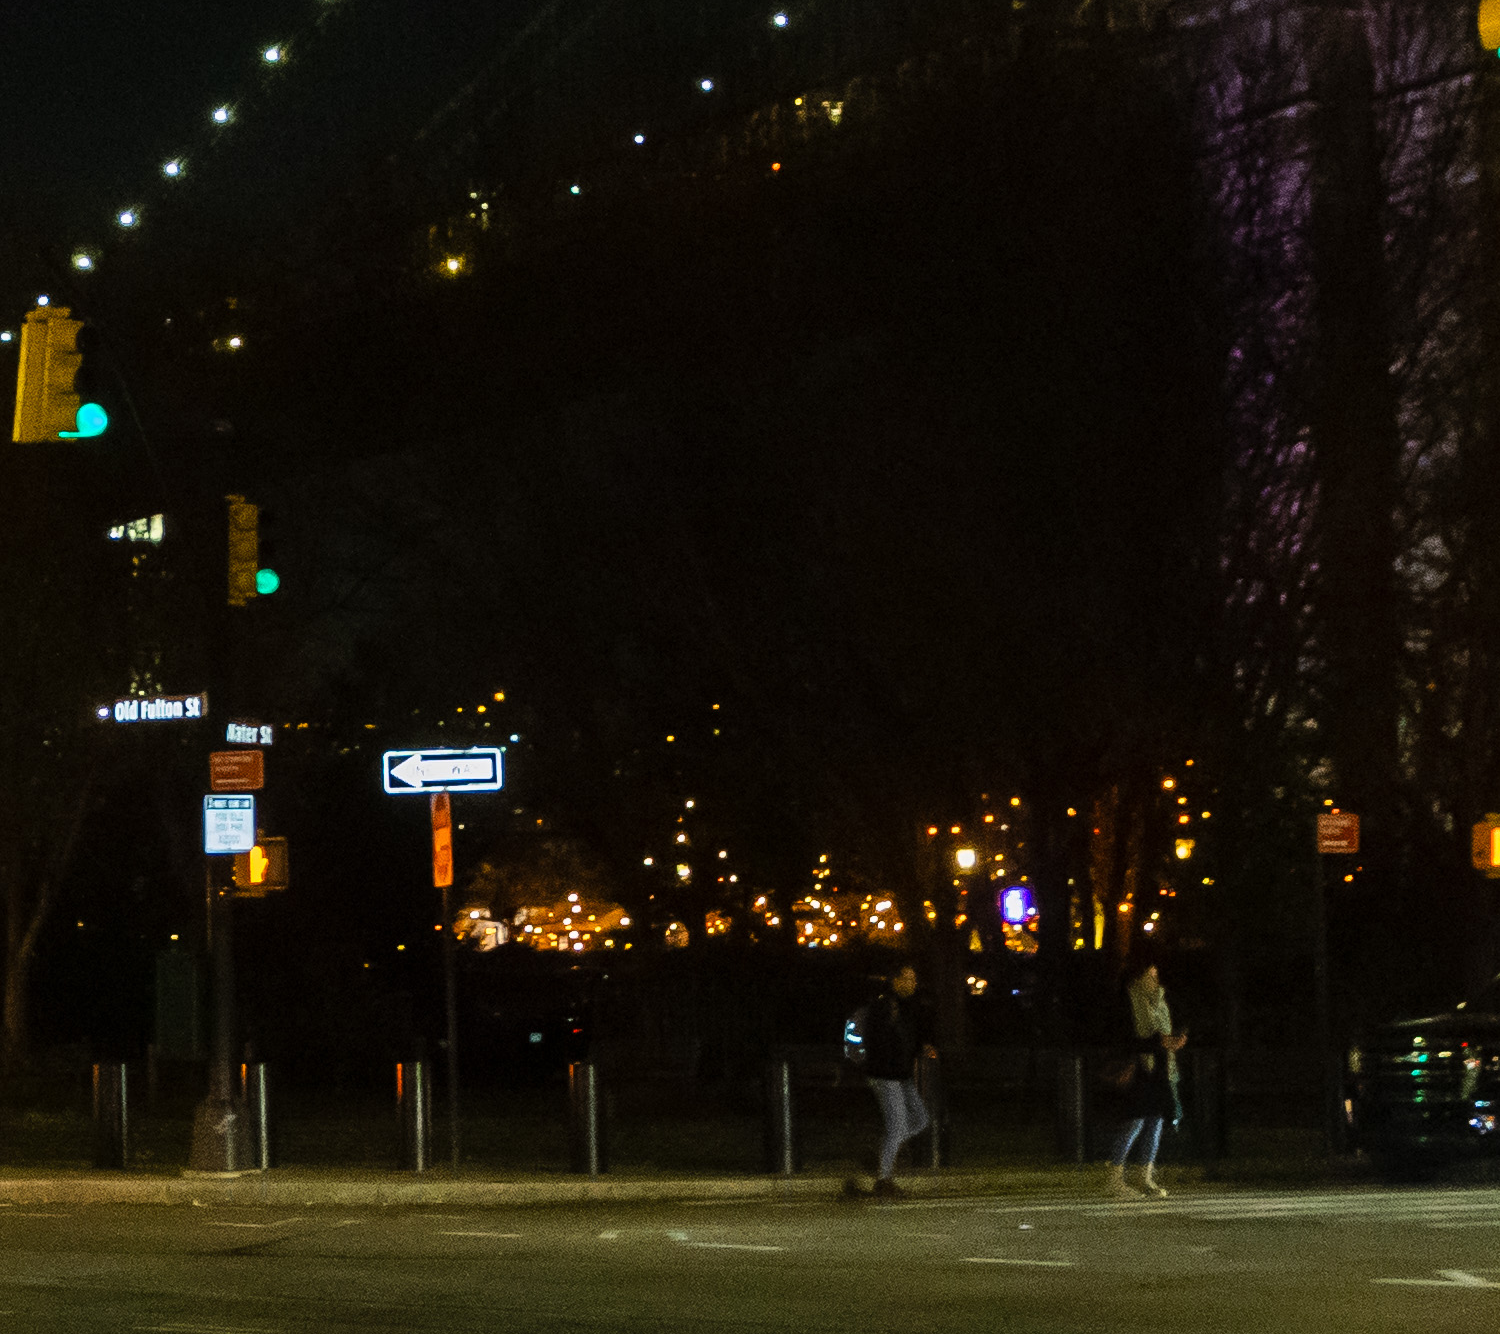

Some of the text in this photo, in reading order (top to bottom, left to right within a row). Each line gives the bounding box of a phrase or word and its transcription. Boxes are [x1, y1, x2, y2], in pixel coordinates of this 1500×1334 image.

[115, 697, 201, 721] Old Fulton St
